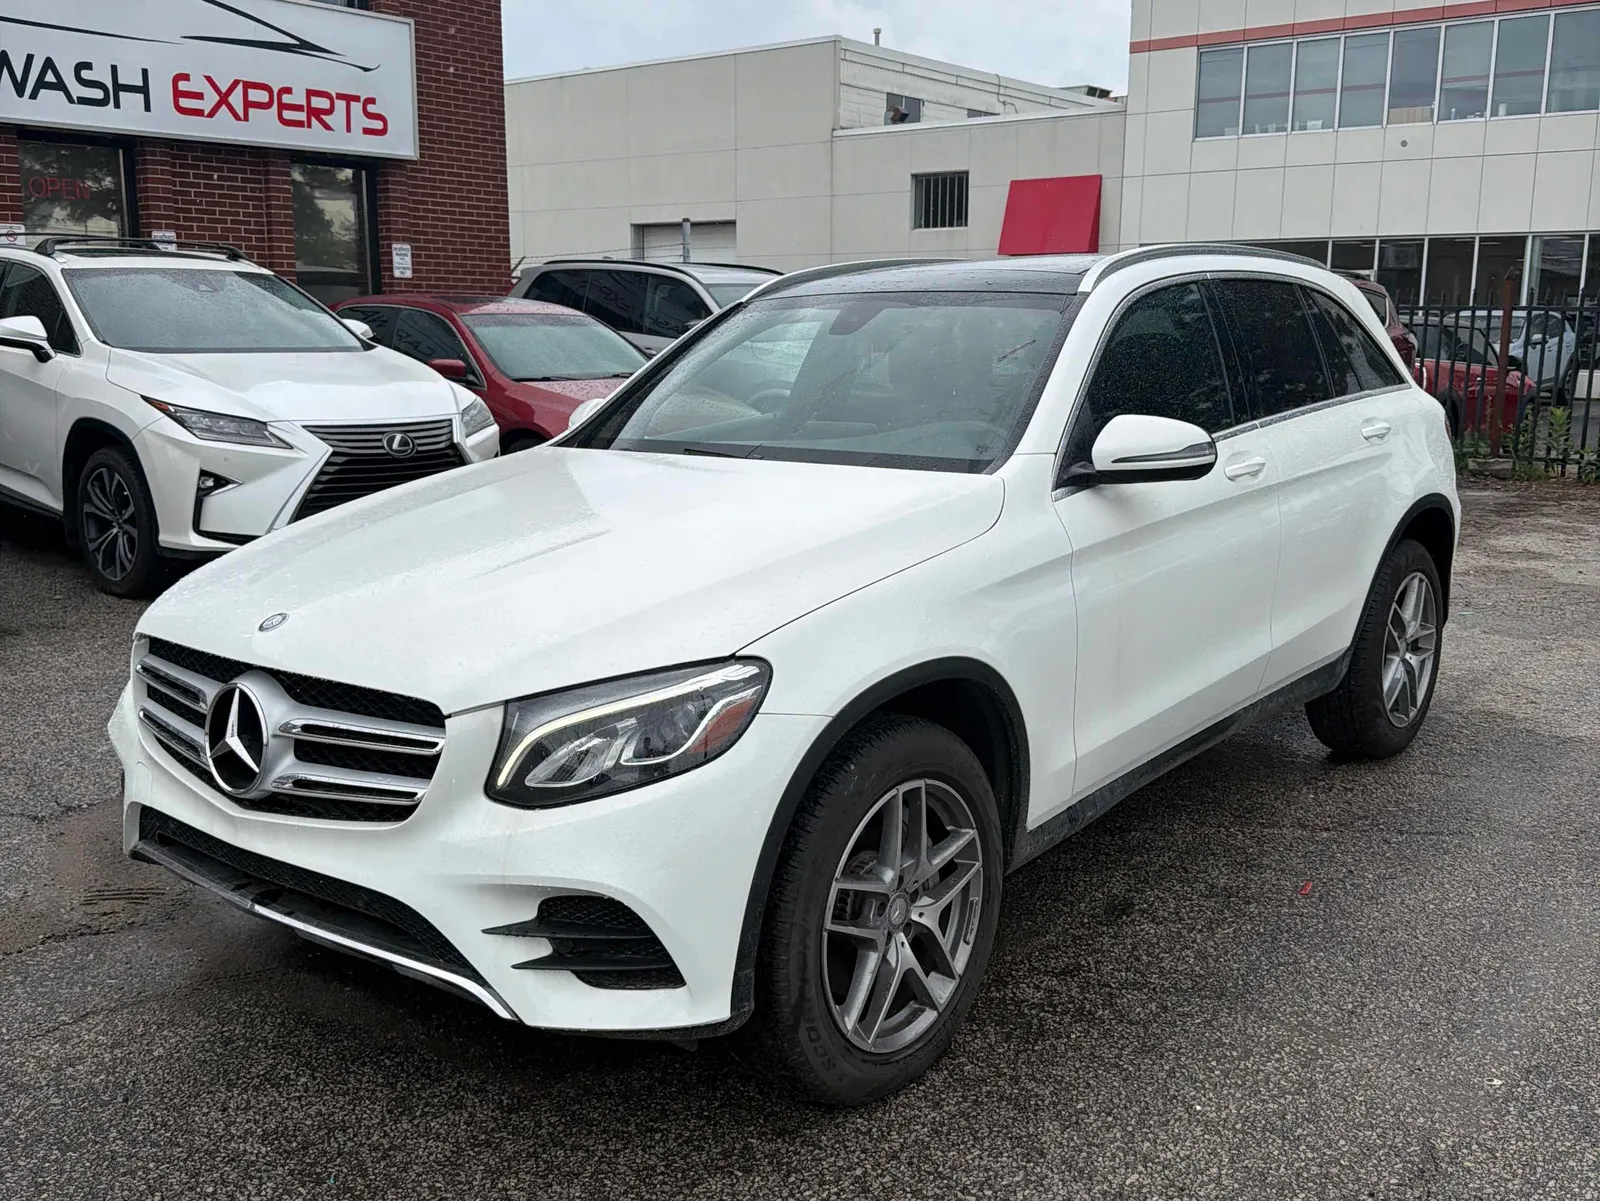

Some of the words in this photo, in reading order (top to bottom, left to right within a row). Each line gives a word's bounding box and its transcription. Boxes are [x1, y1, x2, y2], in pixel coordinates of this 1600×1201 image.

[0, 49, 152, 113] WASH
[171, 72, 389, 137] EXPERTS
[28, 176, 90, 201] OPEN
